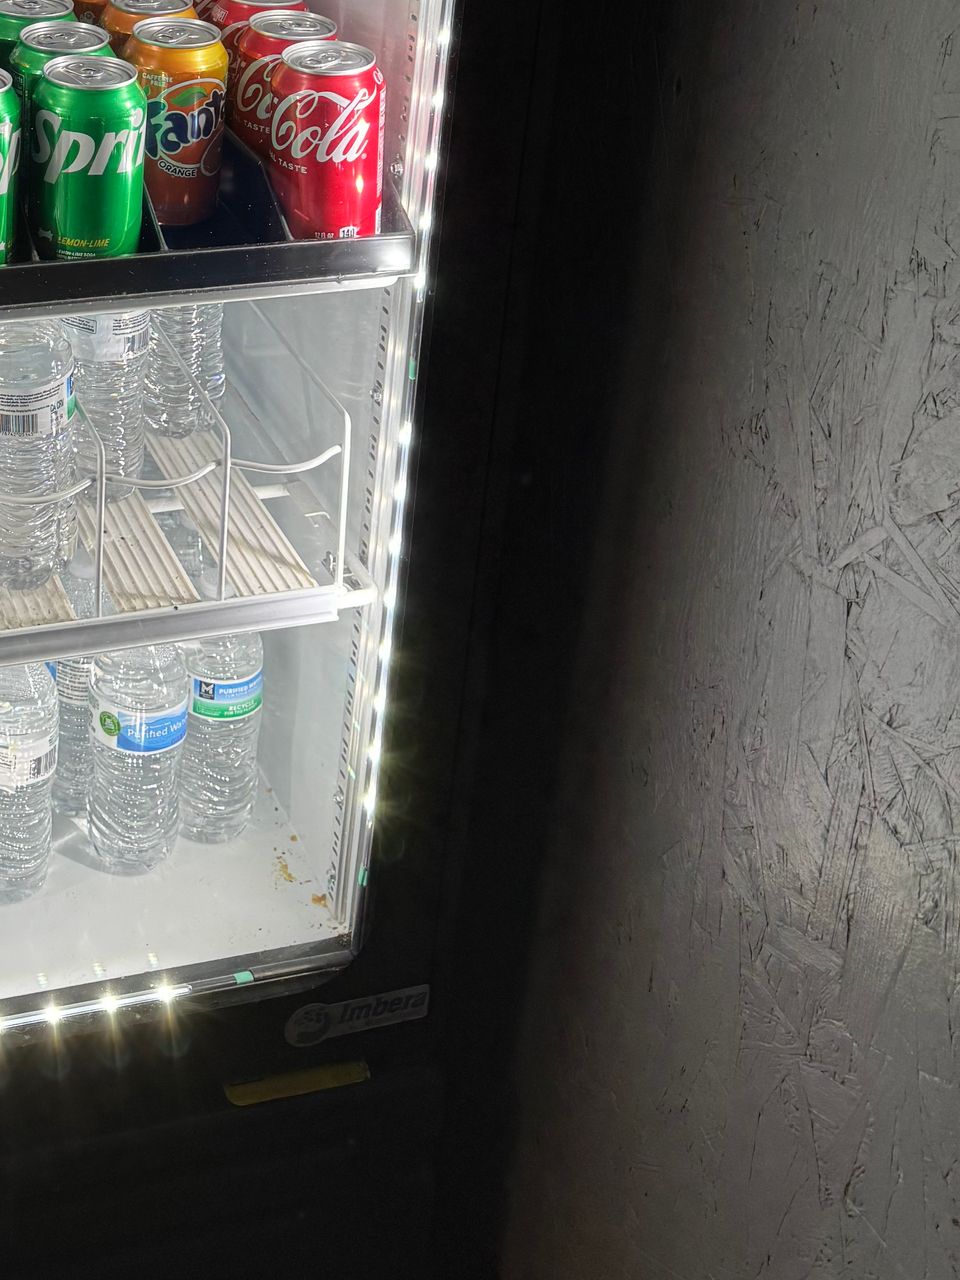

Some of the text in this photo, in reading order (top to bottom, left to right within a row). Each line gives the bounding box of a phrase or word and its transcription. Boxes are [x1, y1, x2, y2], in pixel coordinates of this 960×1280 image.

[144, 89, 226, 159] Fant
[159, 160, 197, 178] ORANGE
[278, 158, 308, 174] TASTE
[57, 236, 111, 248] LEMON-LIME
[127, 726, 168, 739] Puified
